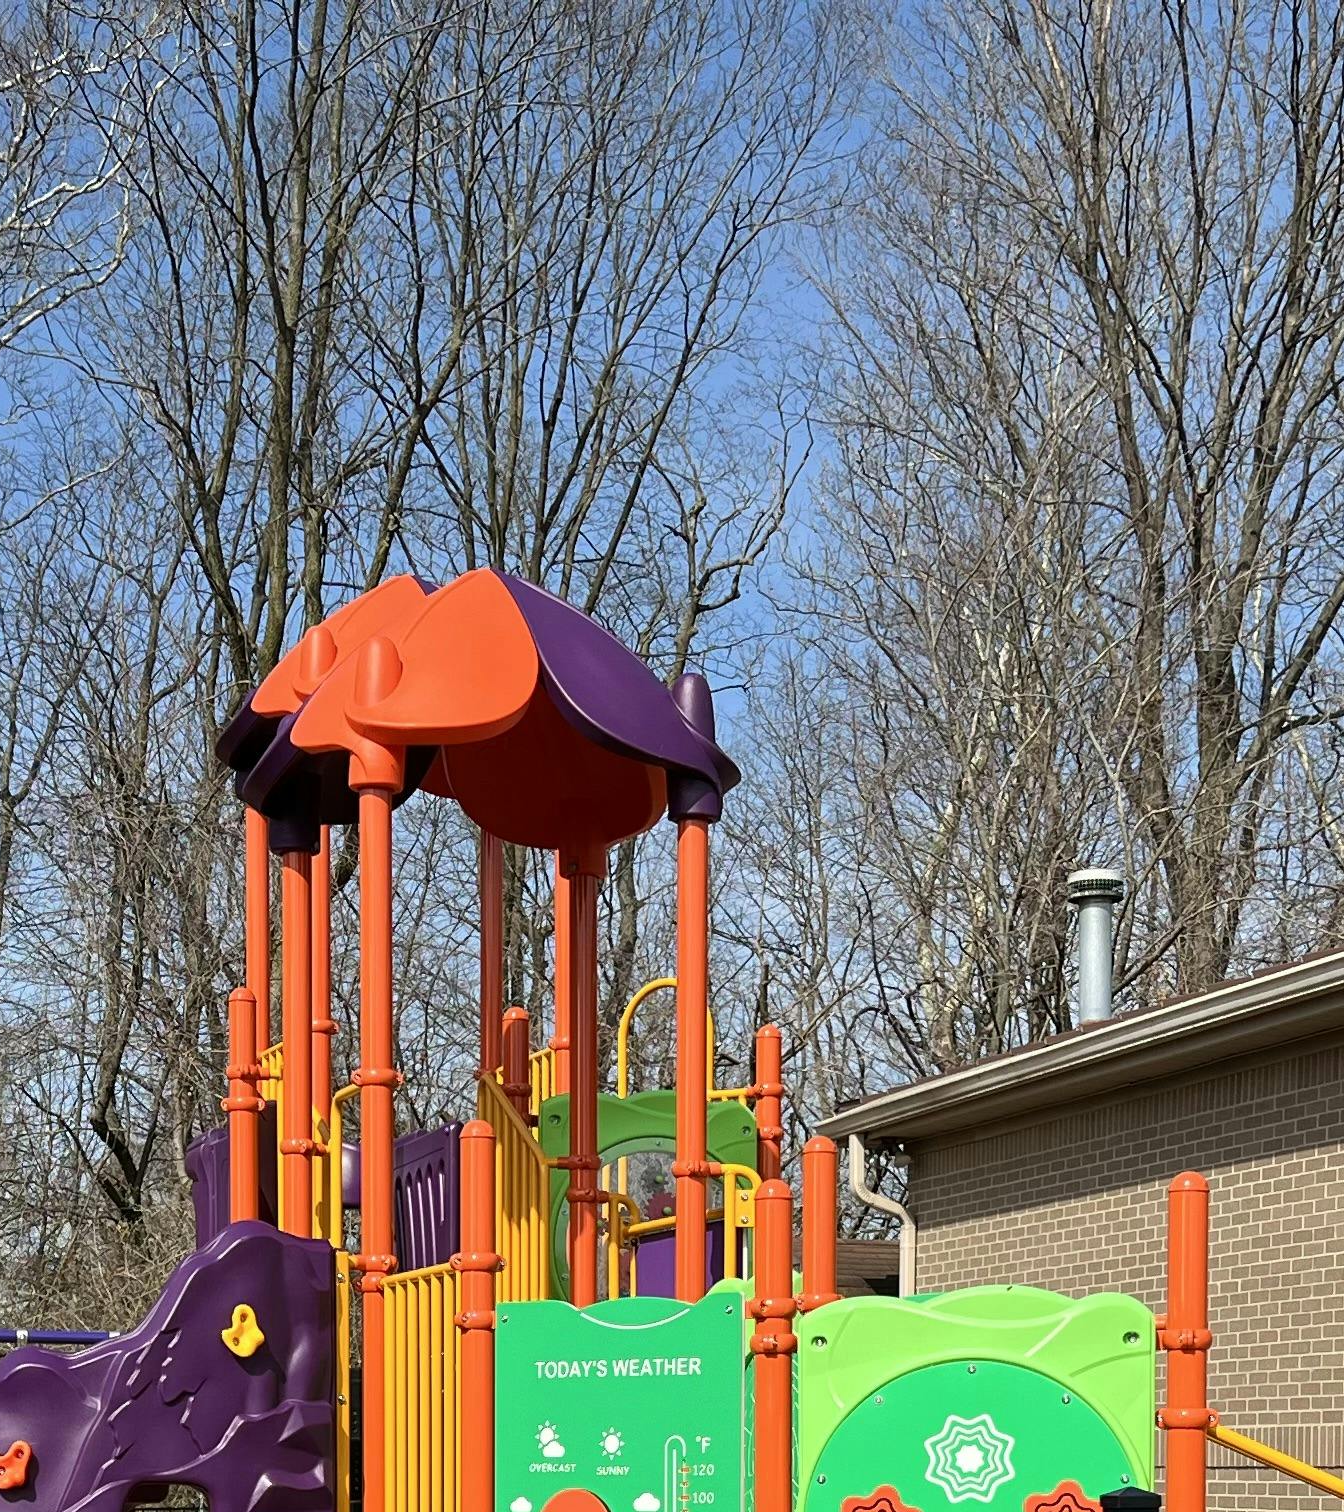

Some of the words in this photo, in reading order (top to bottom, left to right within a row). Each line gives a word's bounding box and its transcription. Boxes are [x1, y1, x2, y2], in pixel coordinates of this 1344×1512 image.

[534, 1360, 607, 1378] TODAY'S
[612, 1358, 702, 1376] WEATHER
[529, 1463, 577, 1473] OVERCAST
[596, 1466, 630, 1476] SUNNY
[692, 1463, 715, 1476] 120
[692, 1491, 715, 1504] 100
